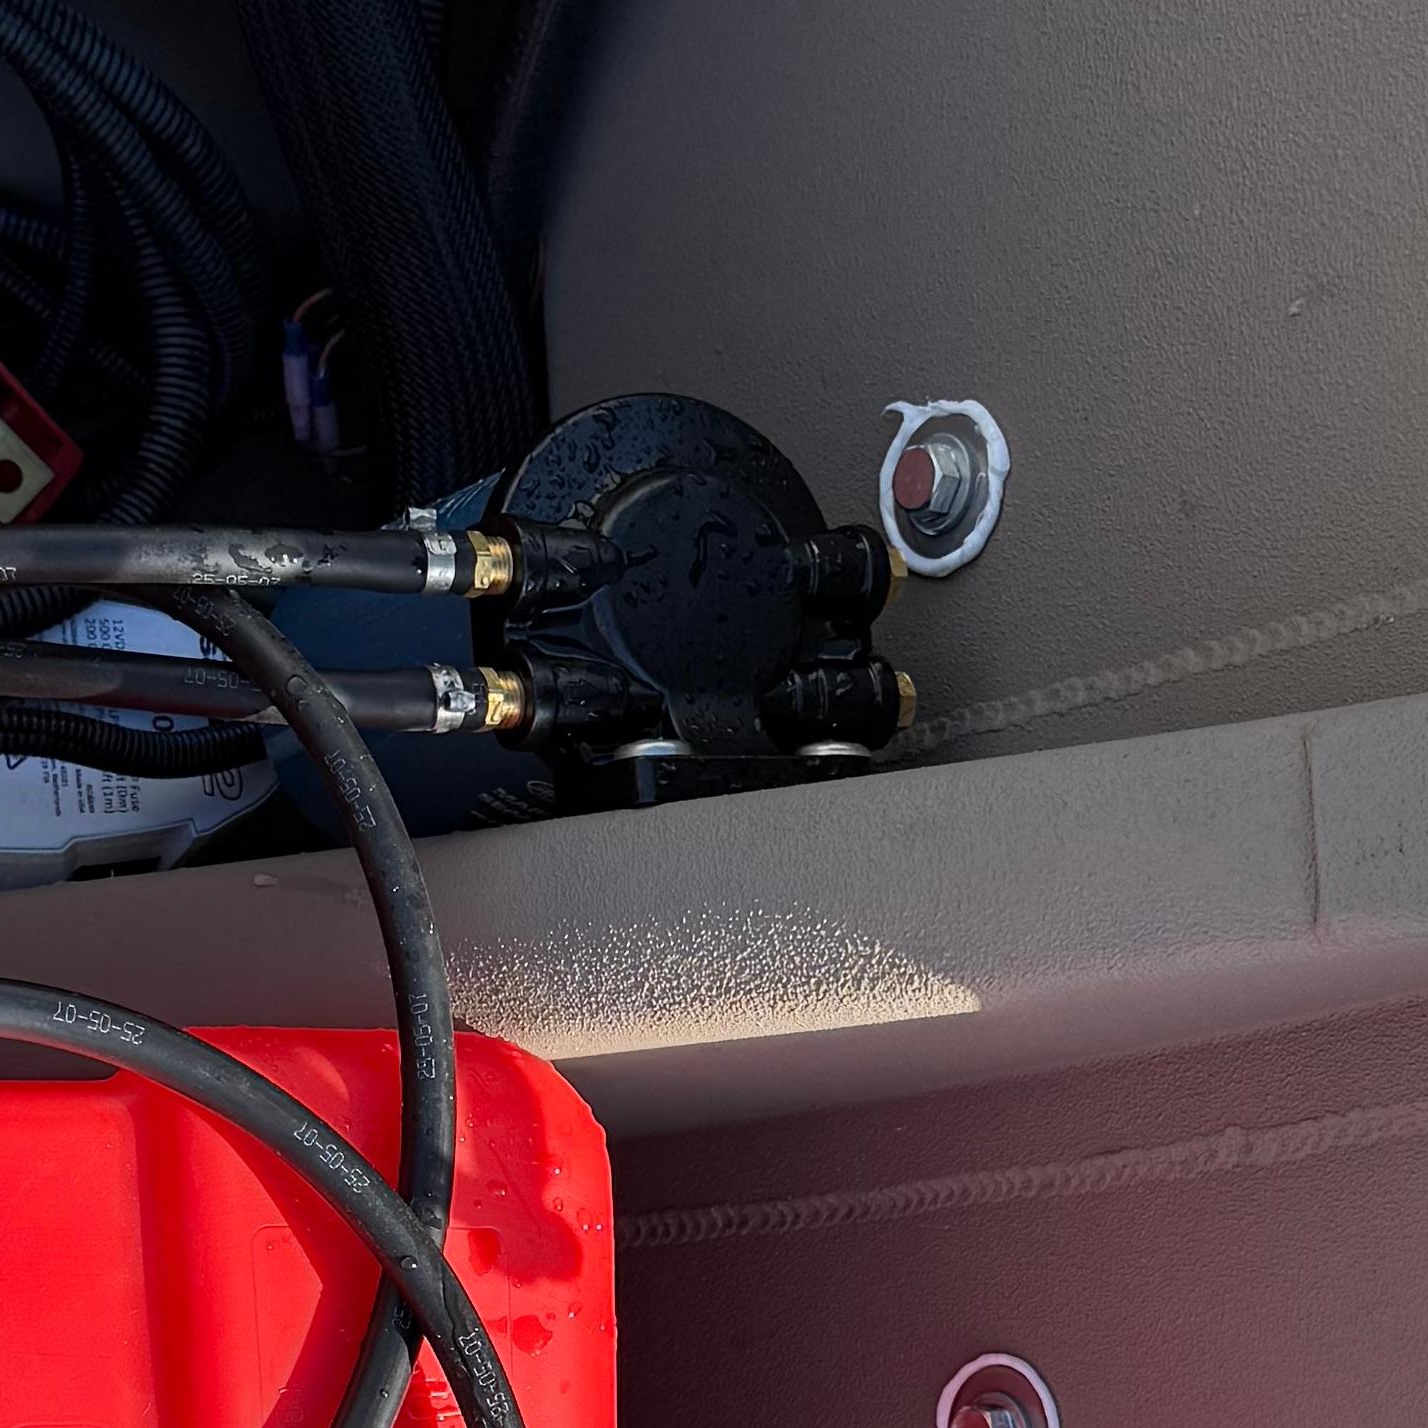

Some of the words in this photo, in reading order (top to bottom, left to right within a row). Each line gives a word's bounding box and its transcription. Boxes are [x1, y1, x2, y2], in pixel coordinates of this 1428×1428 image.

[324, 750, 376, 832] 25-05-07
[53, 1001, 147, 1045] 25-05-07
[409, 993, 436, 1080] 25-05-07
[293, 1122, 370, 1194] 25-05-07
